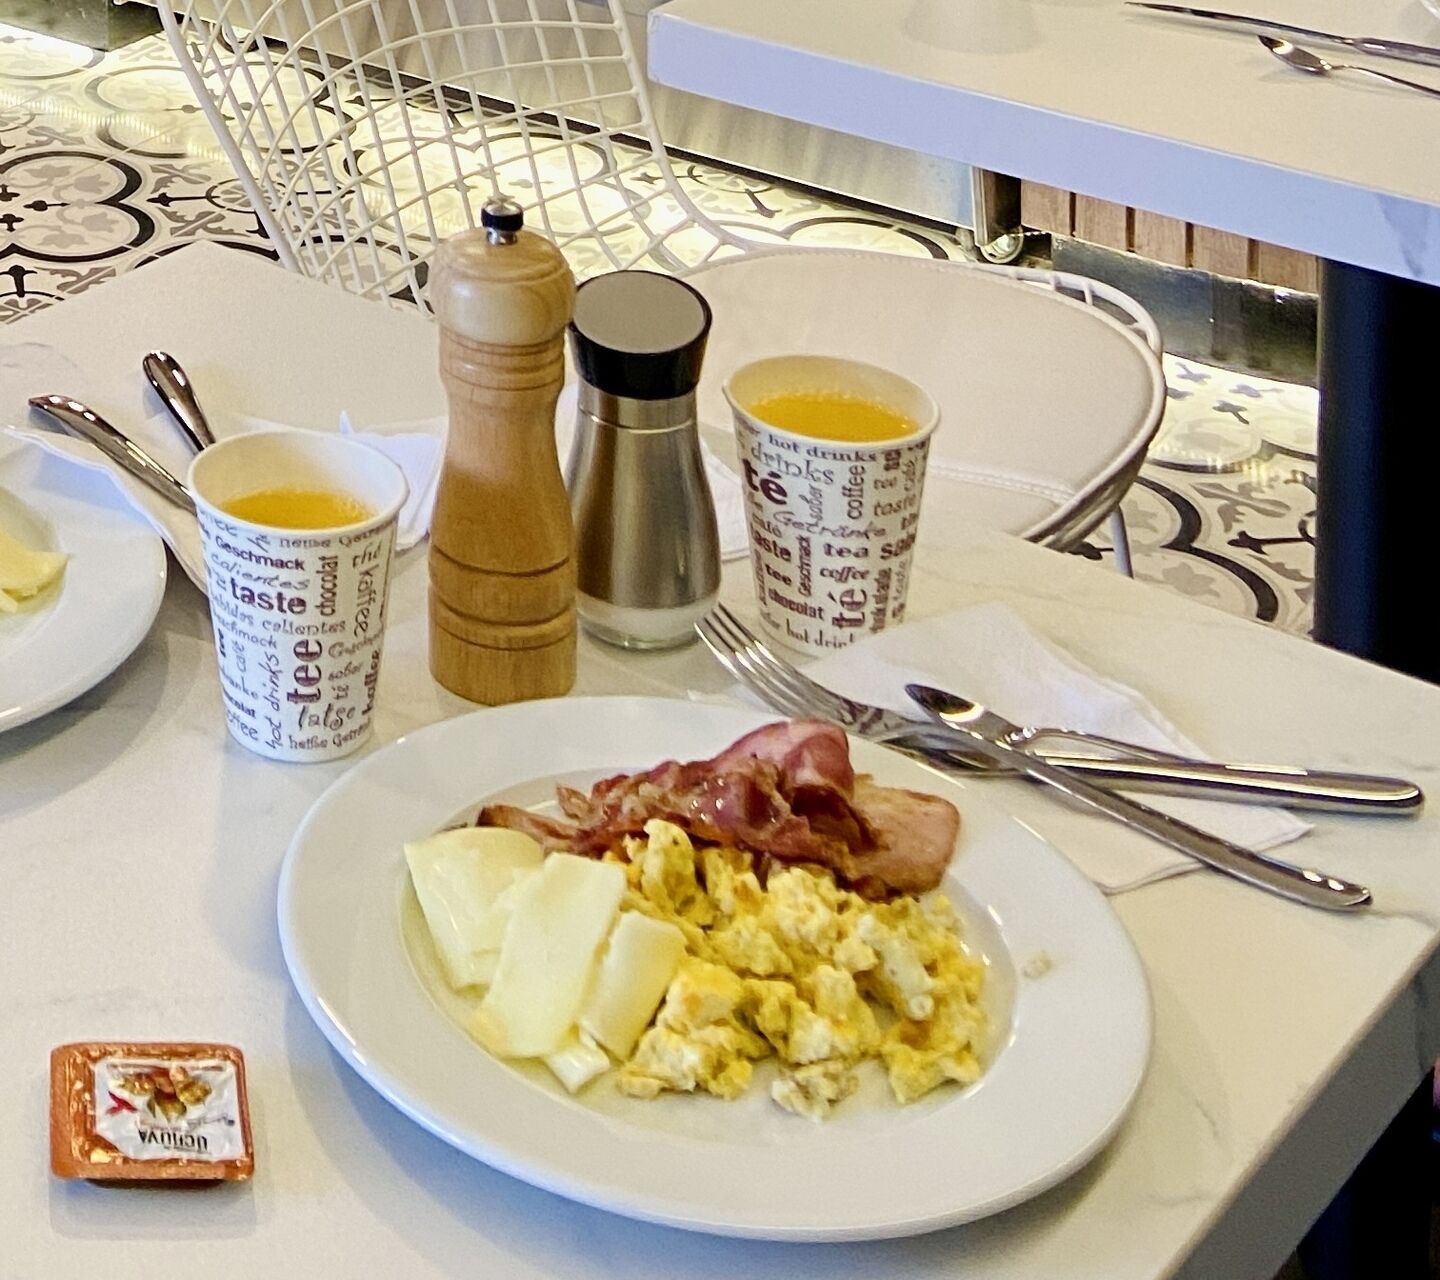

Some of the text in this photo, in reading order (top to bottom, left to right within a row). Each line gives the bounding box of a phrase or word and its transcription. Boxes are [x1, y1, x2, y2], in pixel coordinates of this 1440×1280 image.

[751, 442, 835, 486] drinks
[806, 446, 877, 462] drinks
[842, 465, 866, 520] coffee
[215, 535, 306, 571] Geschmack
[823, 543, 868, 558] tea
[230, 577, 307, 616] taste
[315, 555, 338, 617] chocolat
[262, 619, 346, 637] calientes
[286, 639, 323, 704] tee
[258, 651, 284, 750] hot drinks
